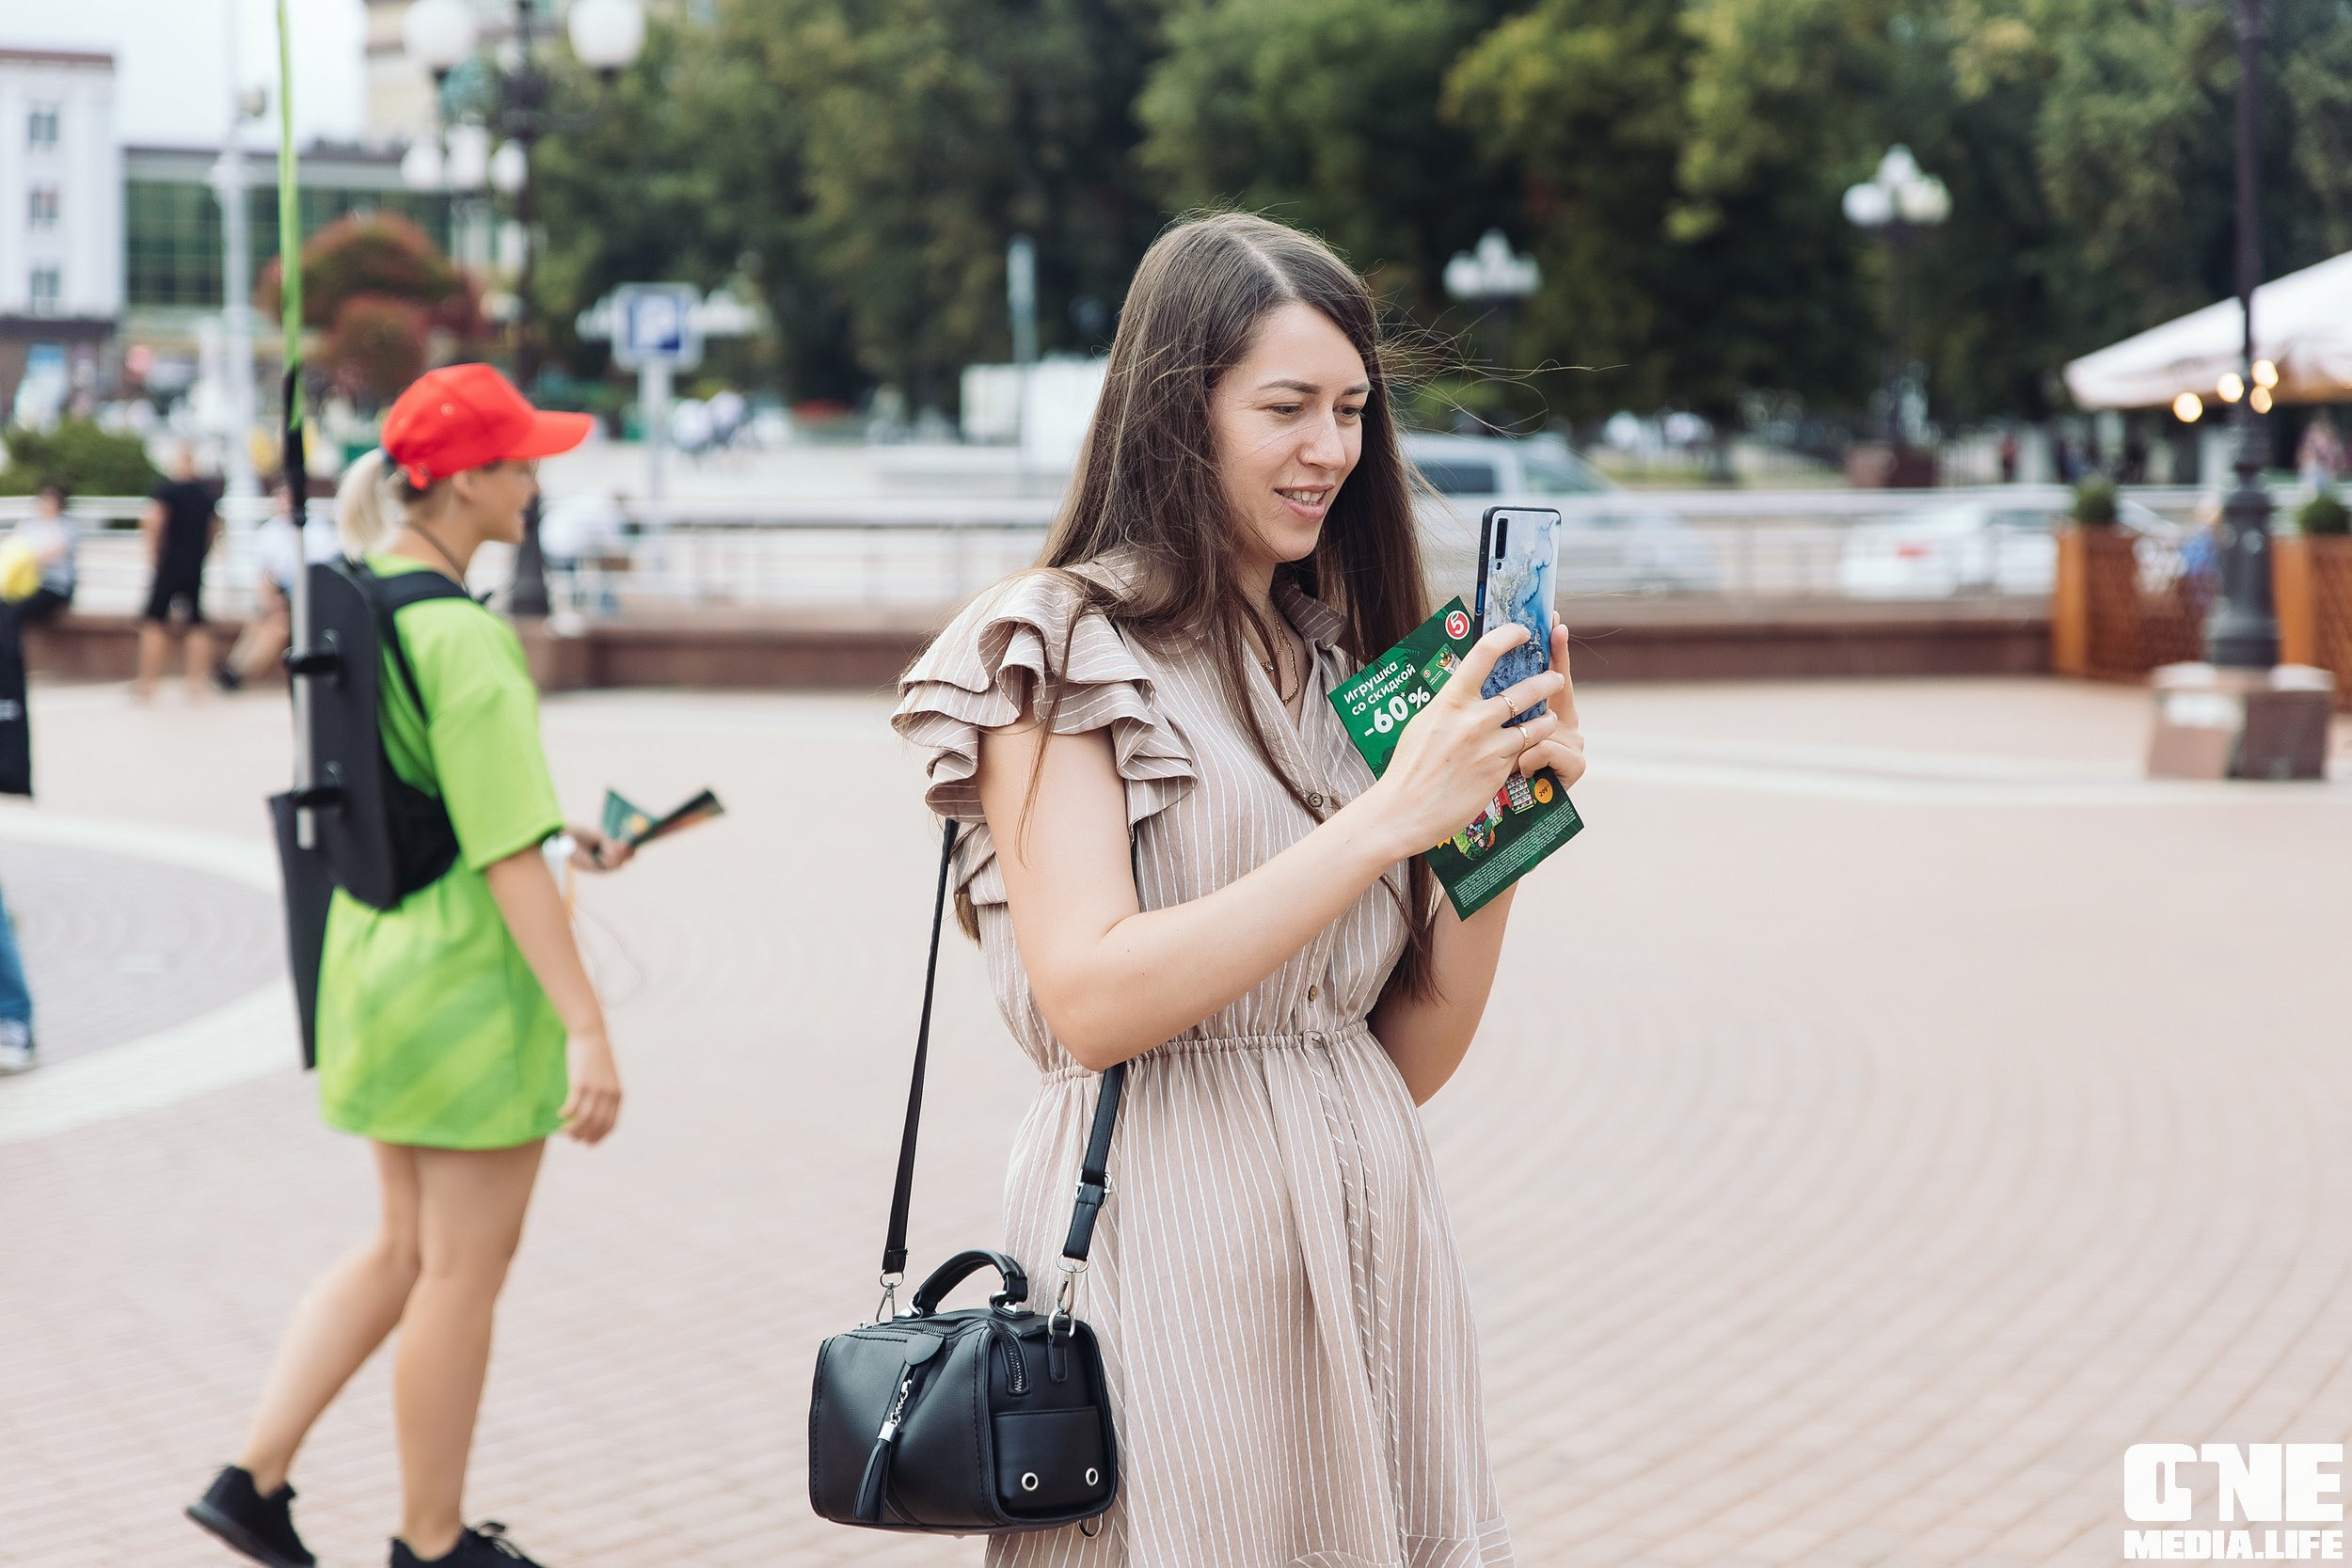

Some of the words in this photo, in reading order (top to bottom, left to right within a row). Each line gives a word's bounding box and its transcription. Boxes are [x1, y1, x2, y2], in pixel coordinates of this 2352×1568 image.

[1343, 661, 1399, 704] Игрушка
[1351, 701, 1366, 716] со
[1367, 663, 1416, 705] скидкой
